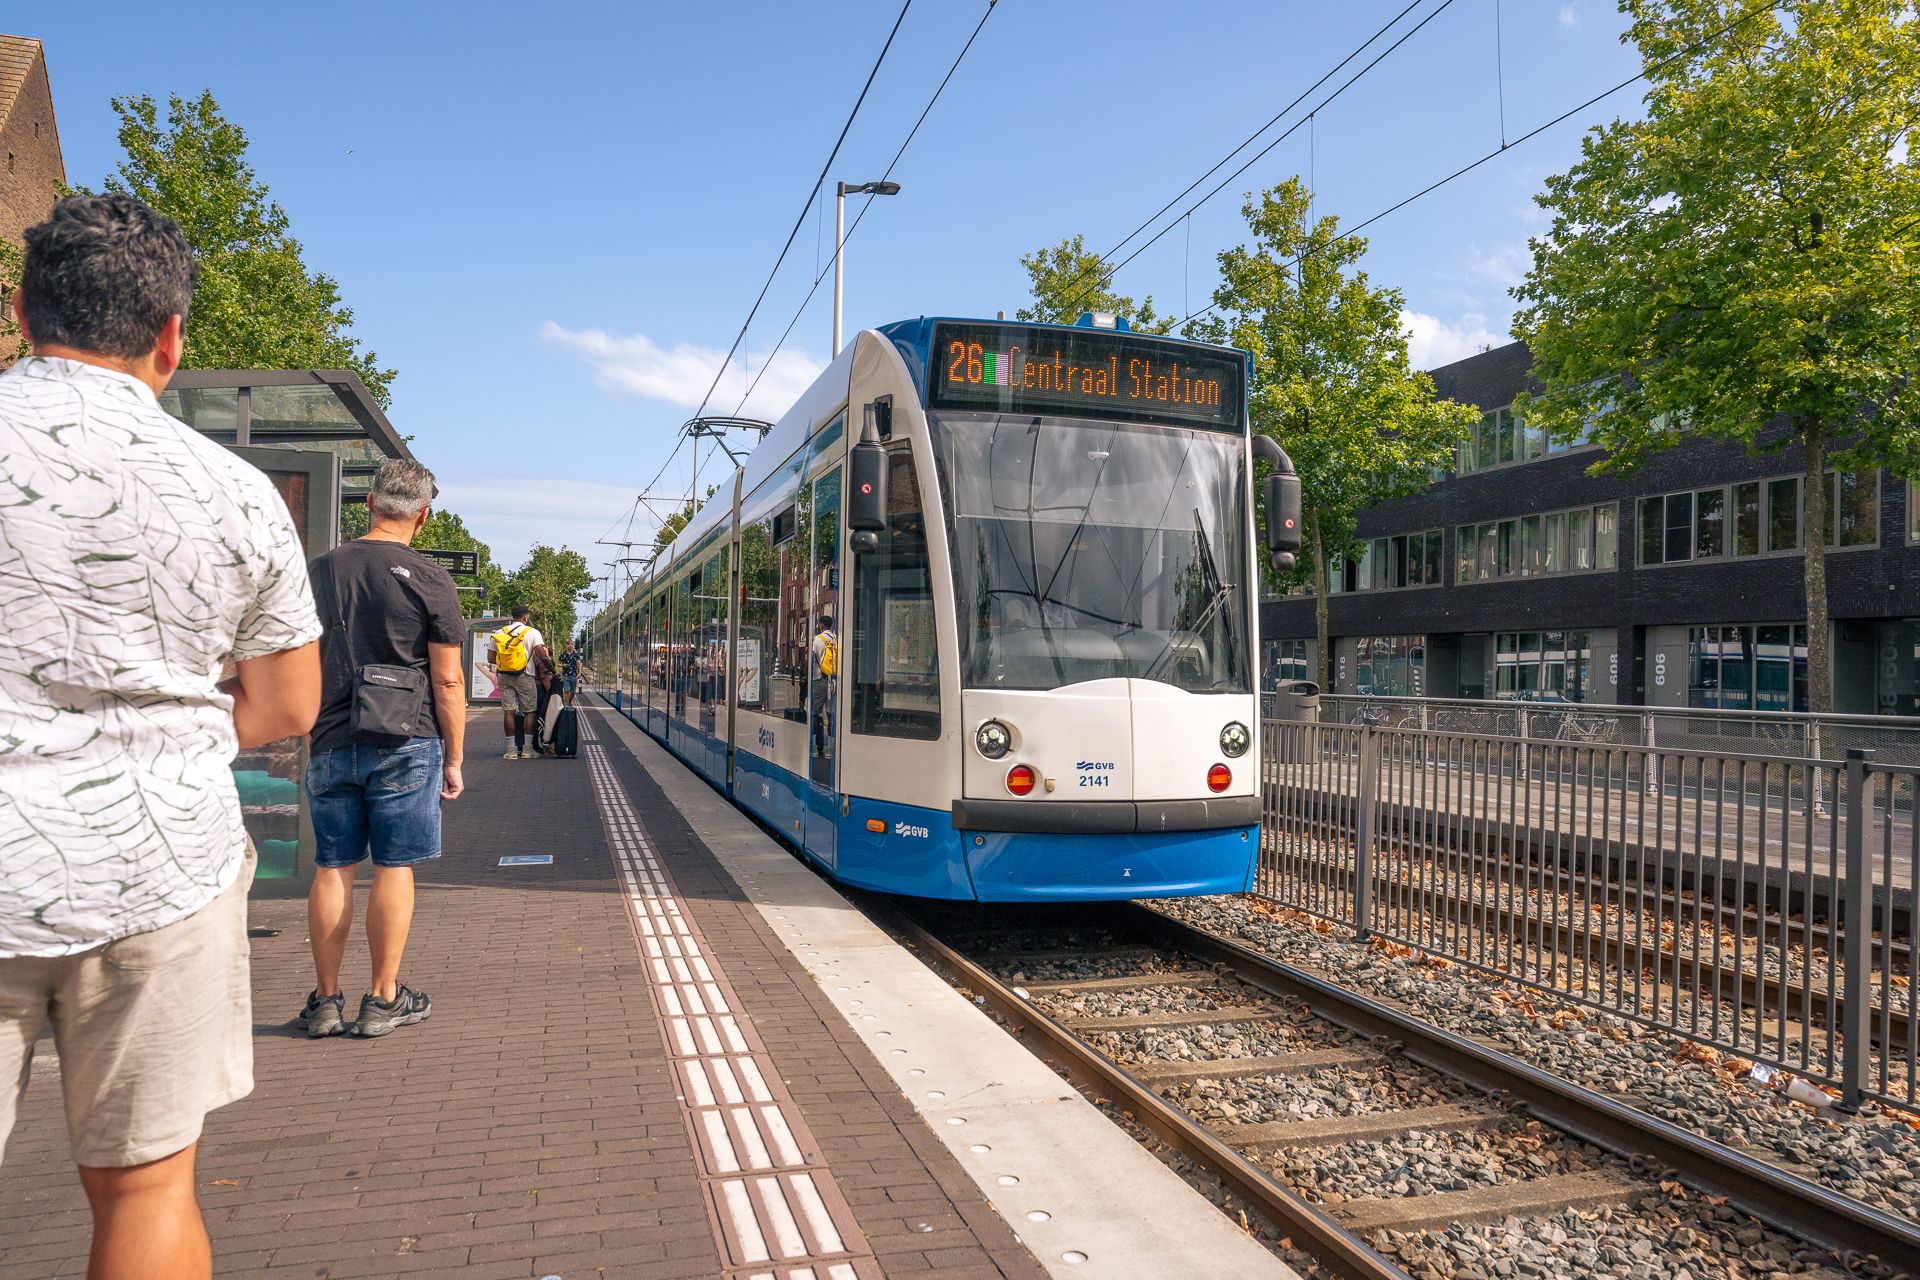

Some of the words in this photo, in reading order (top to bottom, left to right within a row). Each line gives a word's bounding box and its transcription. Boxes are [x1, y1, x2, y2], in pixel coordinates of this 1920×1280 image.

[949, 341, 983, 384] 26
[1009, 346, 1117, 396] Centraal
[1130, 358, 1219, 406] Station
[1609, 653, 1618, 685] 608
[1655, 653, 1666, 686] 606
[1095, 762, 1114, 770] GVB
[1079, 775, 1109, 787] 2141
[911, 826, 929, 838] GVB
